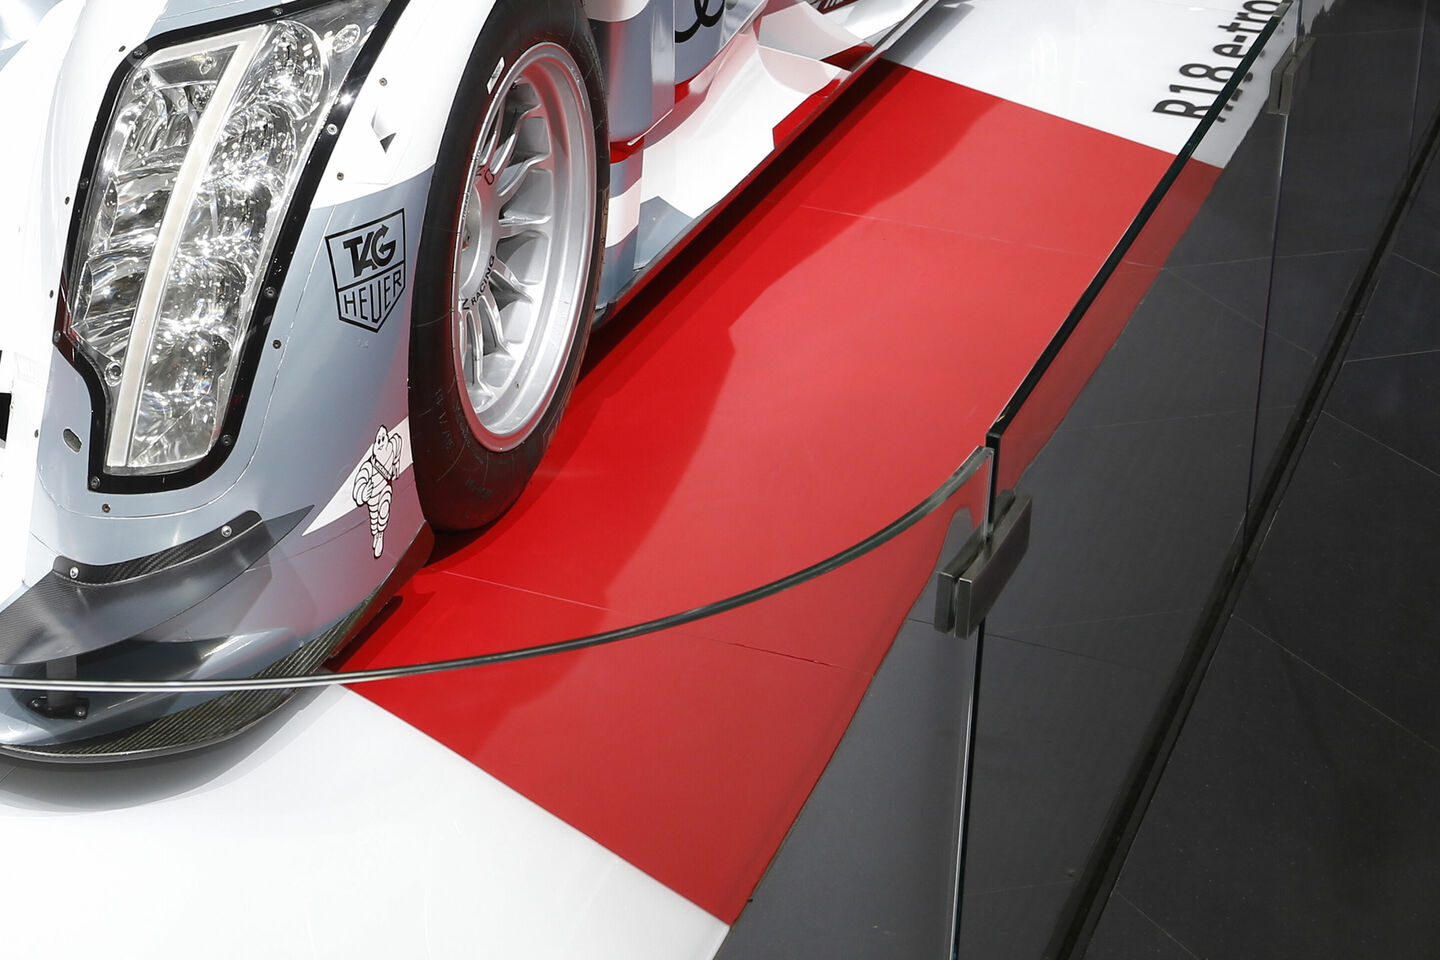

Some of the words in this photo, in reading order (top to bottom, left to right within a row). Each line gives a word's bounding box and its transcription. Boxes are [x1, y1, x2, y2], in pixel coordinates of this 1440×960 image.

[1152, 63, 1238, 120] R18
[343, 224, 397, 278] TAG
[343, 271, 402, 324] HEUER
[470, 255, 496, 306] RACING
